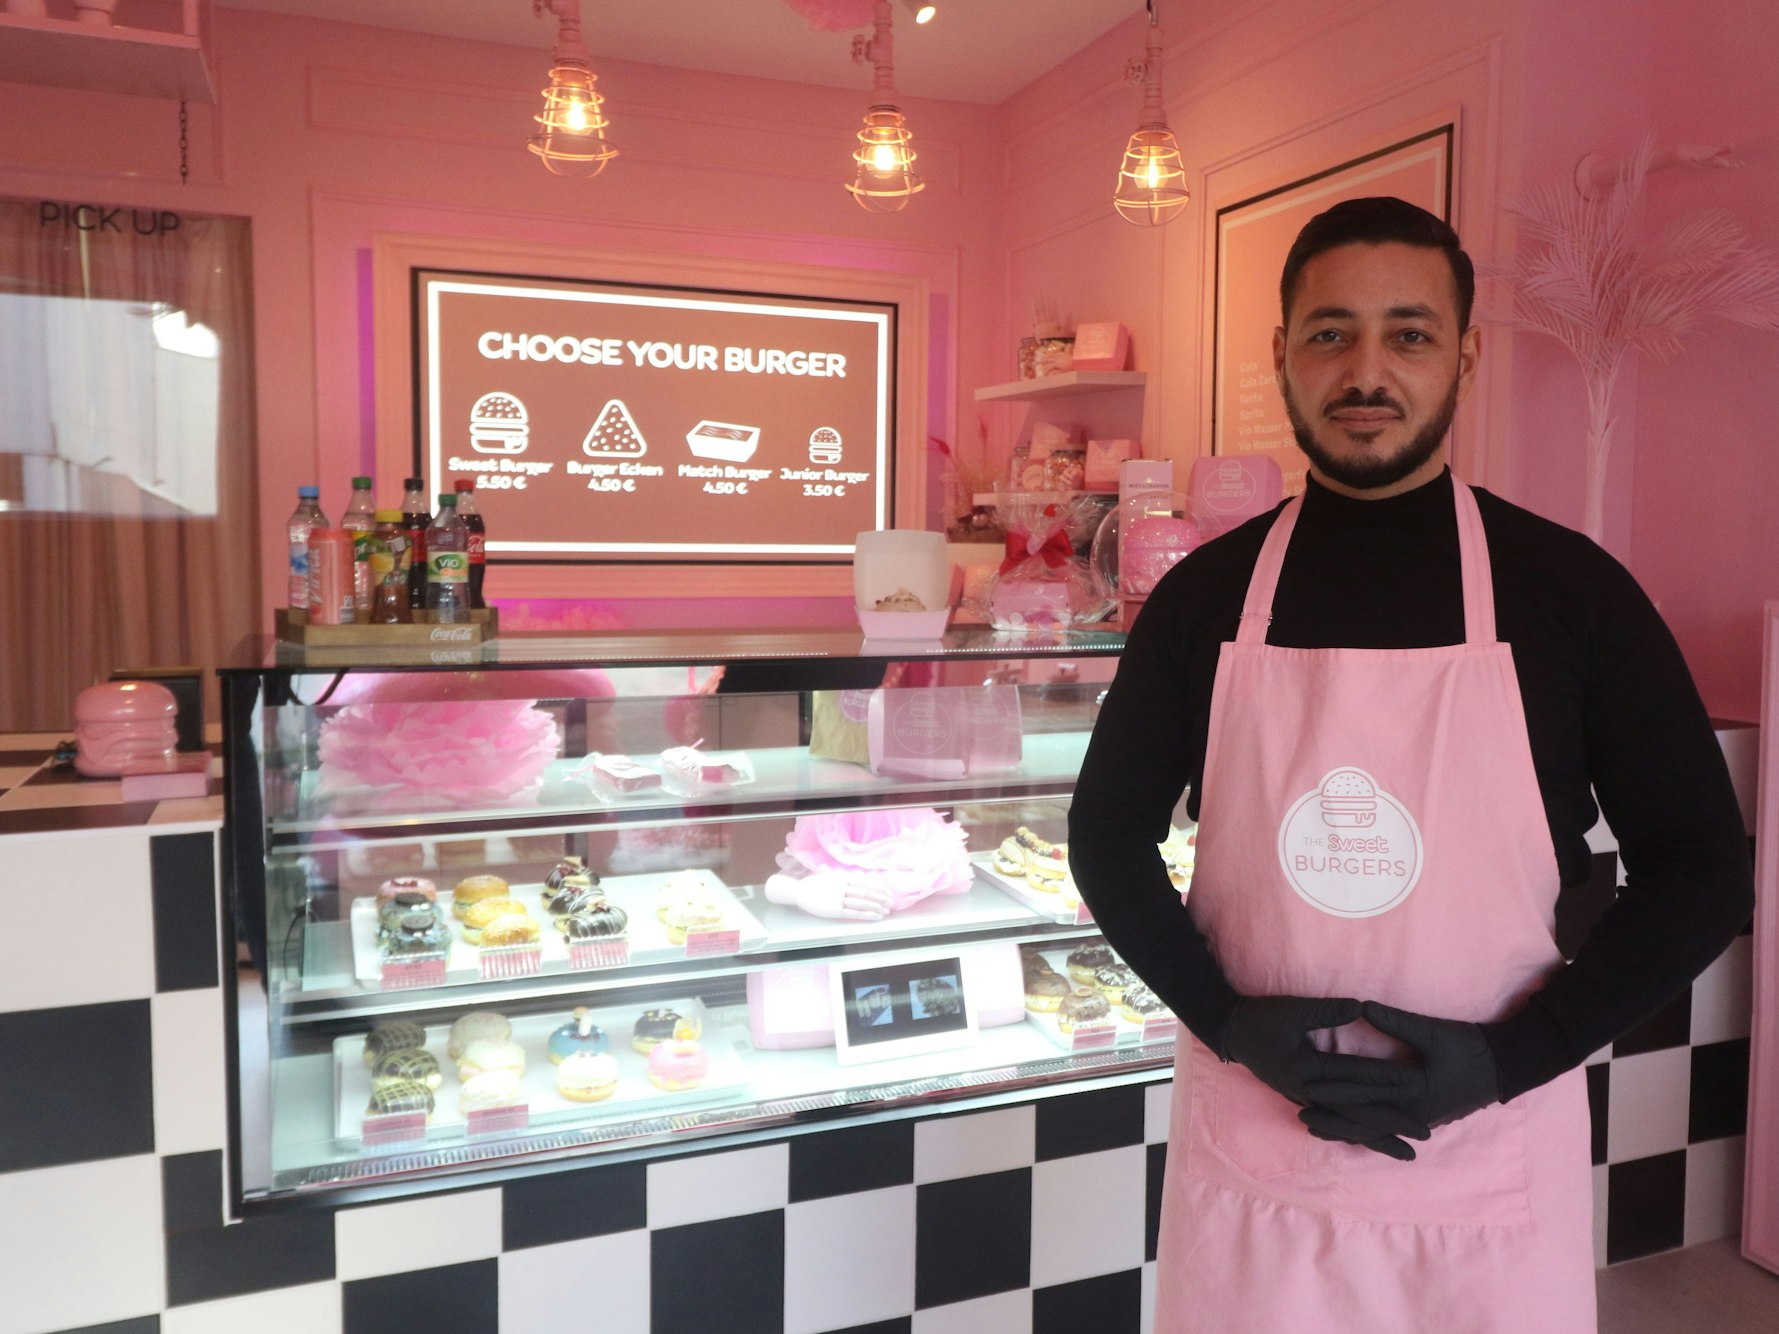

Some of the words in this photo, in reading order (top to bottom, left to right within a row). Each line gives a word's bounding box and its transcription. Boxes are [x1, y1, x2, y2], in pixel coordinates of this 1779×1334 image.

[39, 201, 122, 233] PICK
[132, 211, 181, 235] UP
[477, 331, 624, 366] CHOOSE
[626, 340, 719, 371] YOUR
[724, 346, 847, 378] BURGER
[448, 456, 499, 472] Sweet
[499, 458, 553, 476] Burger
[566, 460, 619, 478] Burger
[619, 463, 664, 477] Ecken
[678, 463, 724, 479] Match
[724, 465, 773, 482] Burger
[474, 475, 513, 489] 5.50
[513, 476, 528, 490] €
[779, 467, 825, 481] Junior
[824, 469, 870, 484] Burger
[587, 478, 622, 492] 4.50
[623, 478, 636, 492] €
[702, 481, 735, 495] 4.50
[736, 482, 748, 495] €
[802, 484, 833, 496] 3.50
[833, 485, 846, 497] €
[1206, 489, 1251, 499] BURGERS
[897, 728, 946, 738] BURGERS
[1303, 836, 1326, 847] THE
[1327, 833, 1389, 854] Sweet
[1295, 855, 1407, 877] BURGERS
